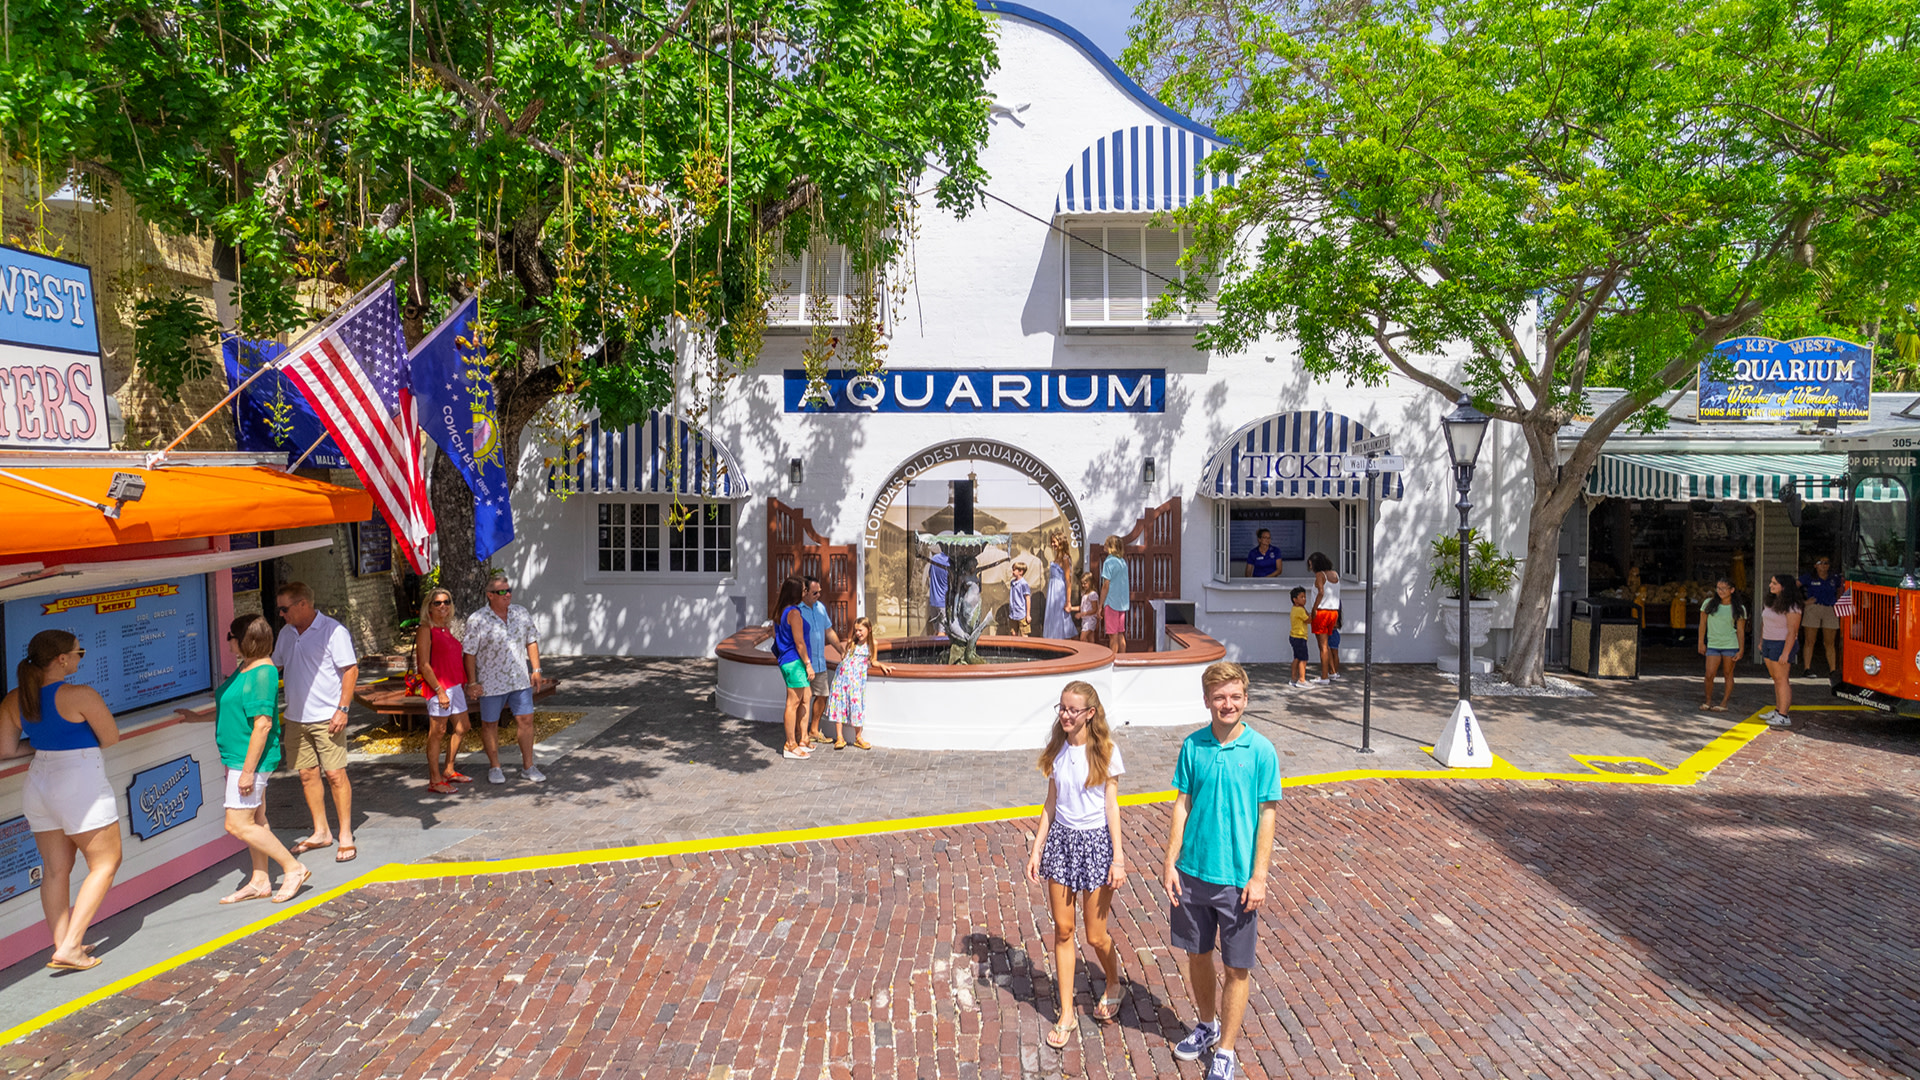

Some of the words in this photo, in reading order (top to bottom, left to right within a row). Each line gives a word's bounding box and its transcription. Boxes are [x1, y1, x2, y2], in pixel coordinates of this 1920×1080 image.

[1745, 339, 1779, 354] KEY
[1788, 339, 1836, 355] WEST
[798, 374, 1151, 410] AQUARIUM
[1727, 384, 1774, 405] Window
[1777, 388, 1793, 406] of
[1793, 384, 1839, 405] Wonder
[1700, 407, 1725, 416] TOURS
[1726, 407, 1741, 416] ARE
[1742, 407, 1765, 416] EVERY
[1767, 407, 1786, 417] HOUR
[1789, 408, 1826, 417] STARTING
[1827, 408, 1837, 417] AT
[1351, 459, 1365, 469] Wall
[1369, 459, 1377, 469] St
[1862, 456, 1879, 466] OFF
[1887, 456, 1917, 467] TOUR
[864, 476, 905, 549] FLORIDA'S
[904, 444, 960, 478] OLDEST
[968, 443, 1049, 483] AQUARIUM
[1048, 482, 1073, 513] EST.
[1069, 516, 1082, 549] 1935
[62, 596, 93, 607] CONCH
[96, 590, 131, 602] FRITTER
[136, 586, 165, 596] STAND
[101, 601, 131, 612] MENU
[153, 608, 177, 620] ORDERS
[140, 631, 166, 642] DRINKS
[139, 666, 174, 680] HOMEMADE
[140, 759, 189, 813] Calamari
[147, 785, 190, 832] Rings
